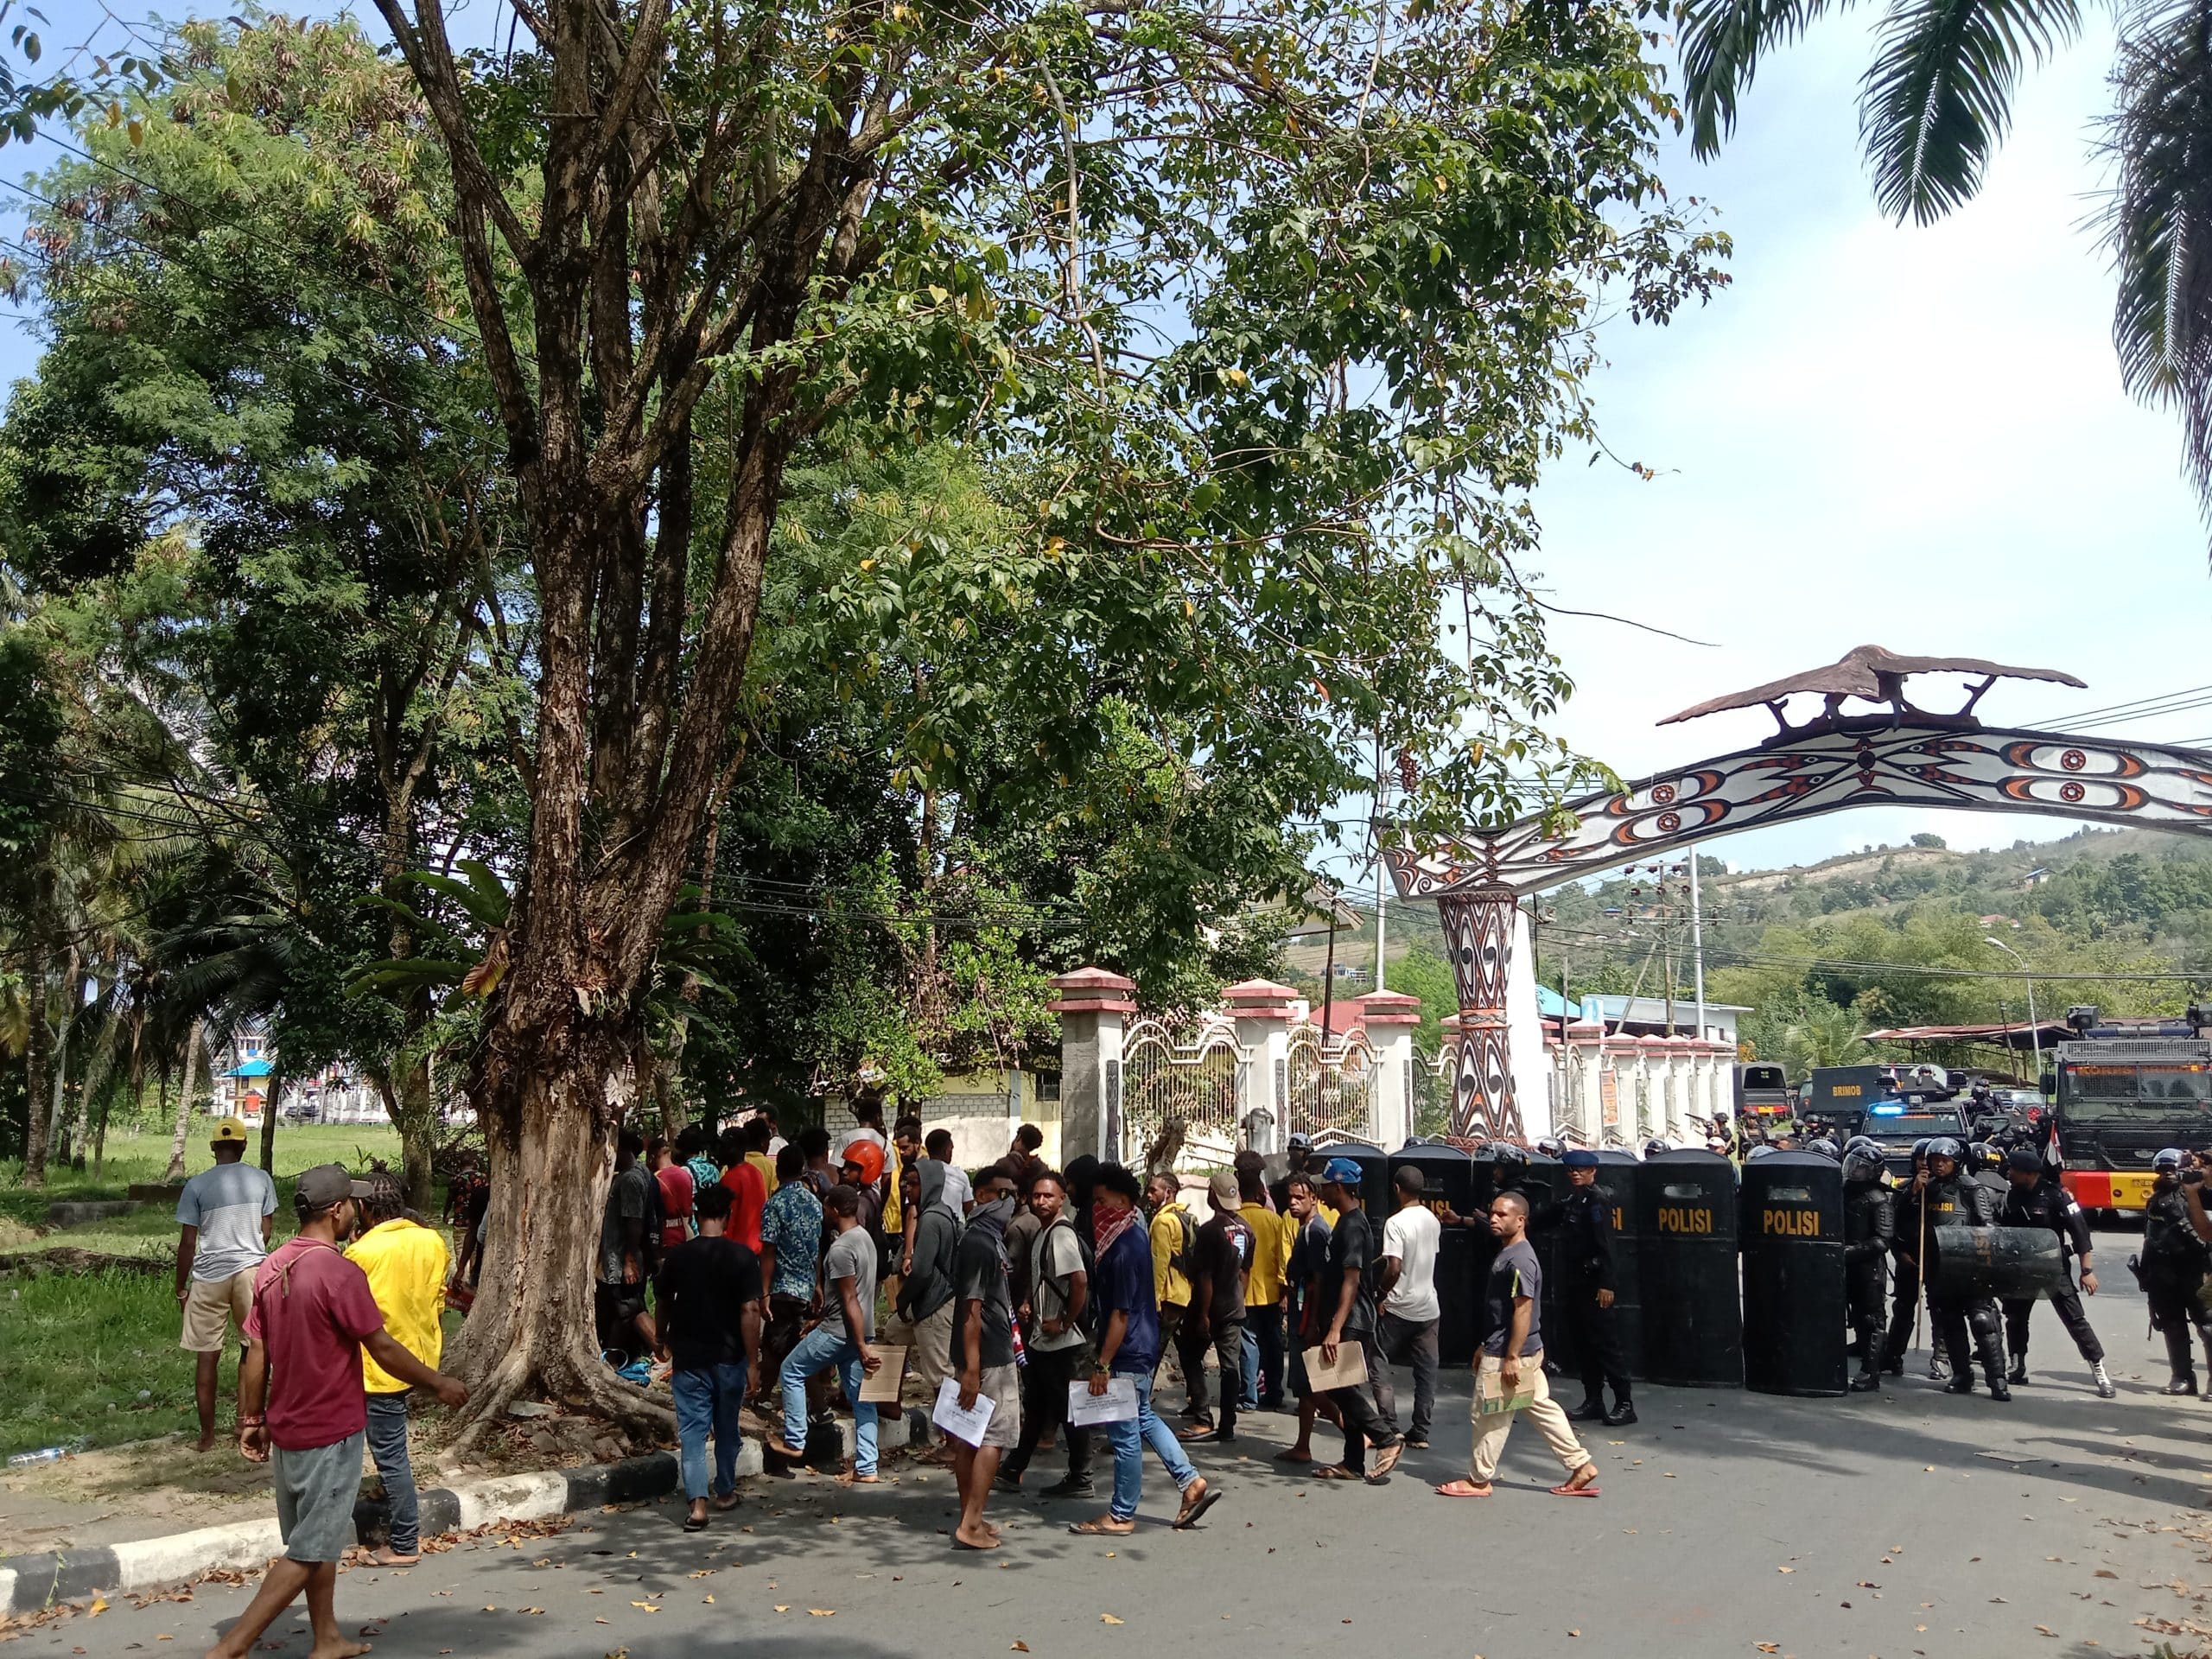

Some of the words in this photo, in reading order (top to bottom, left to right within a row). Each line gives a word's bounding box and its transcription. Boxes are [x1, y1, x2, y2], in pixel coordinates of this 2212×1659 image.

[1832, 1085, 1861, 1096] BRIMOB
[1659, 1208, 1712, 1233] POLISI
[1764, 1210, 1819, 1236] POLISI
